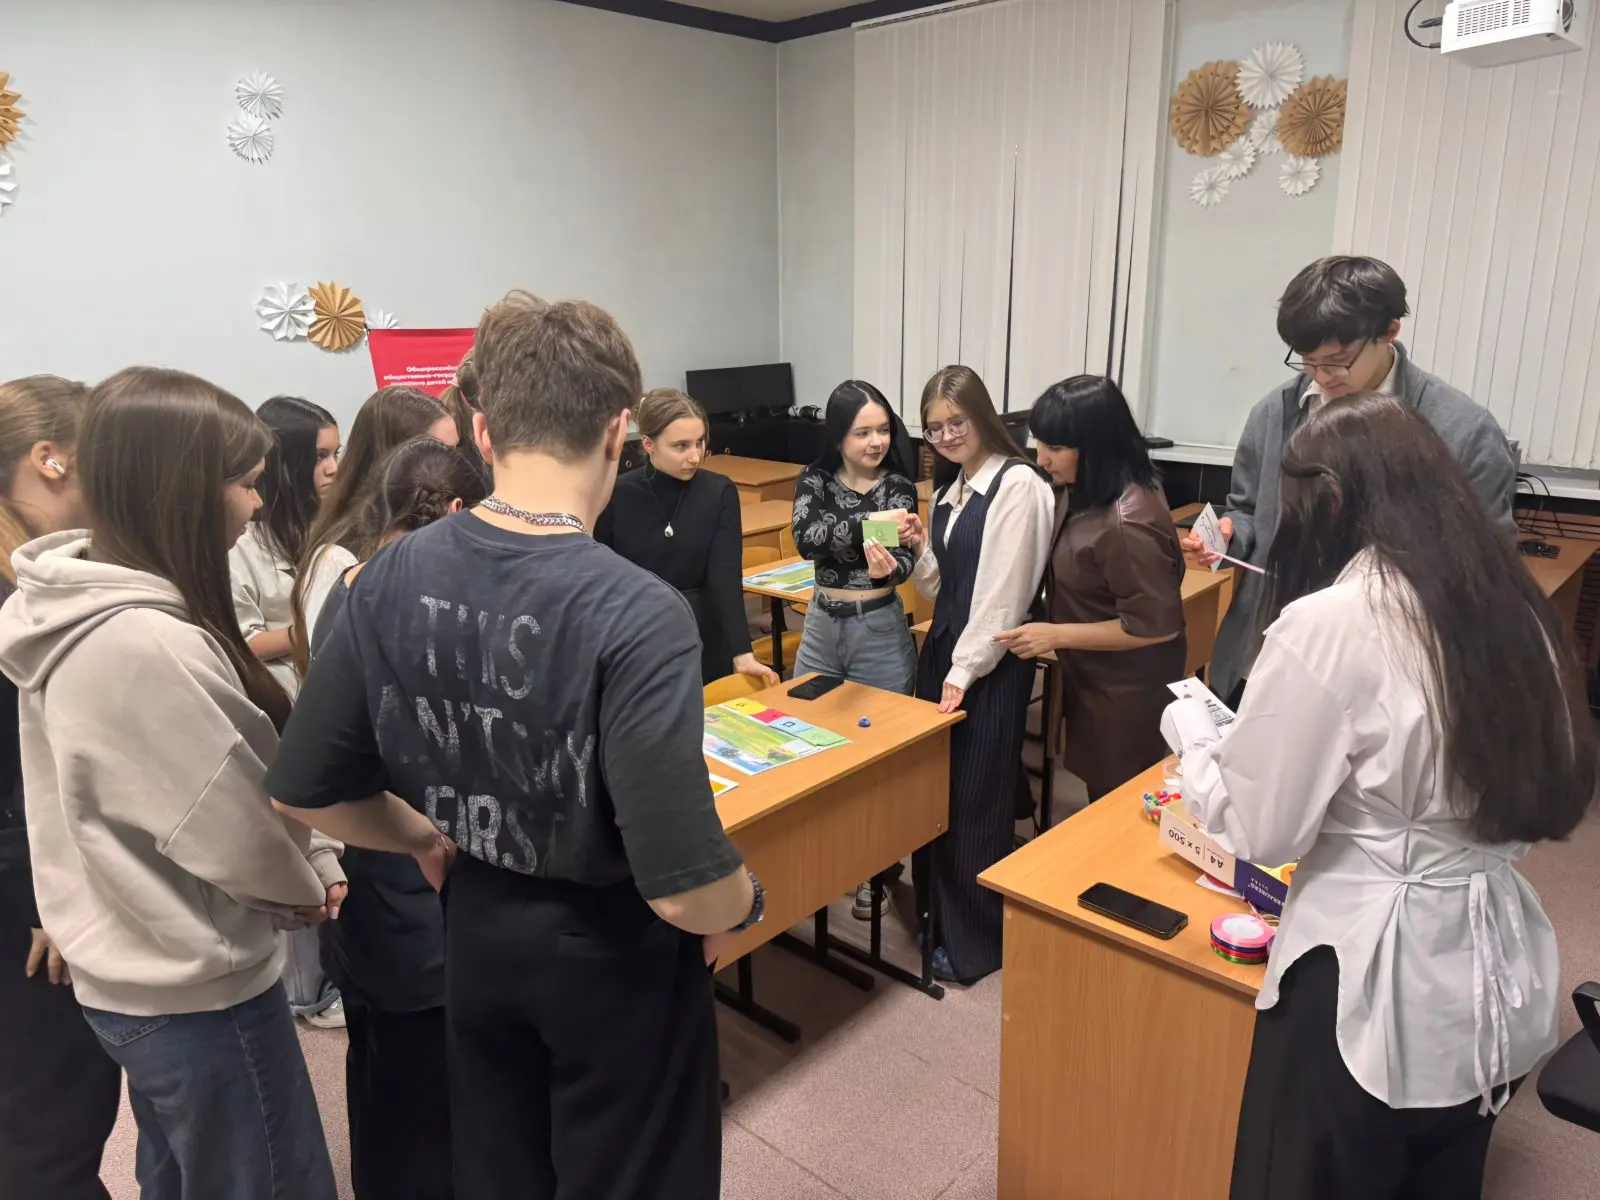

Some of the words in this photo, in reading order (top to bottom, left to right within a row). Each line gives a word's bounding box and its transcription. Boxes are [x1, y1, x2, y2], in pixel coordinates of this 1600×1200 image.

[376, 684, 504, 778] AN'T
[1168, 829, 1185, 845] 500
[1194, 846, 1201, 855] 5
[1210, 855, 1224, 869] A4
